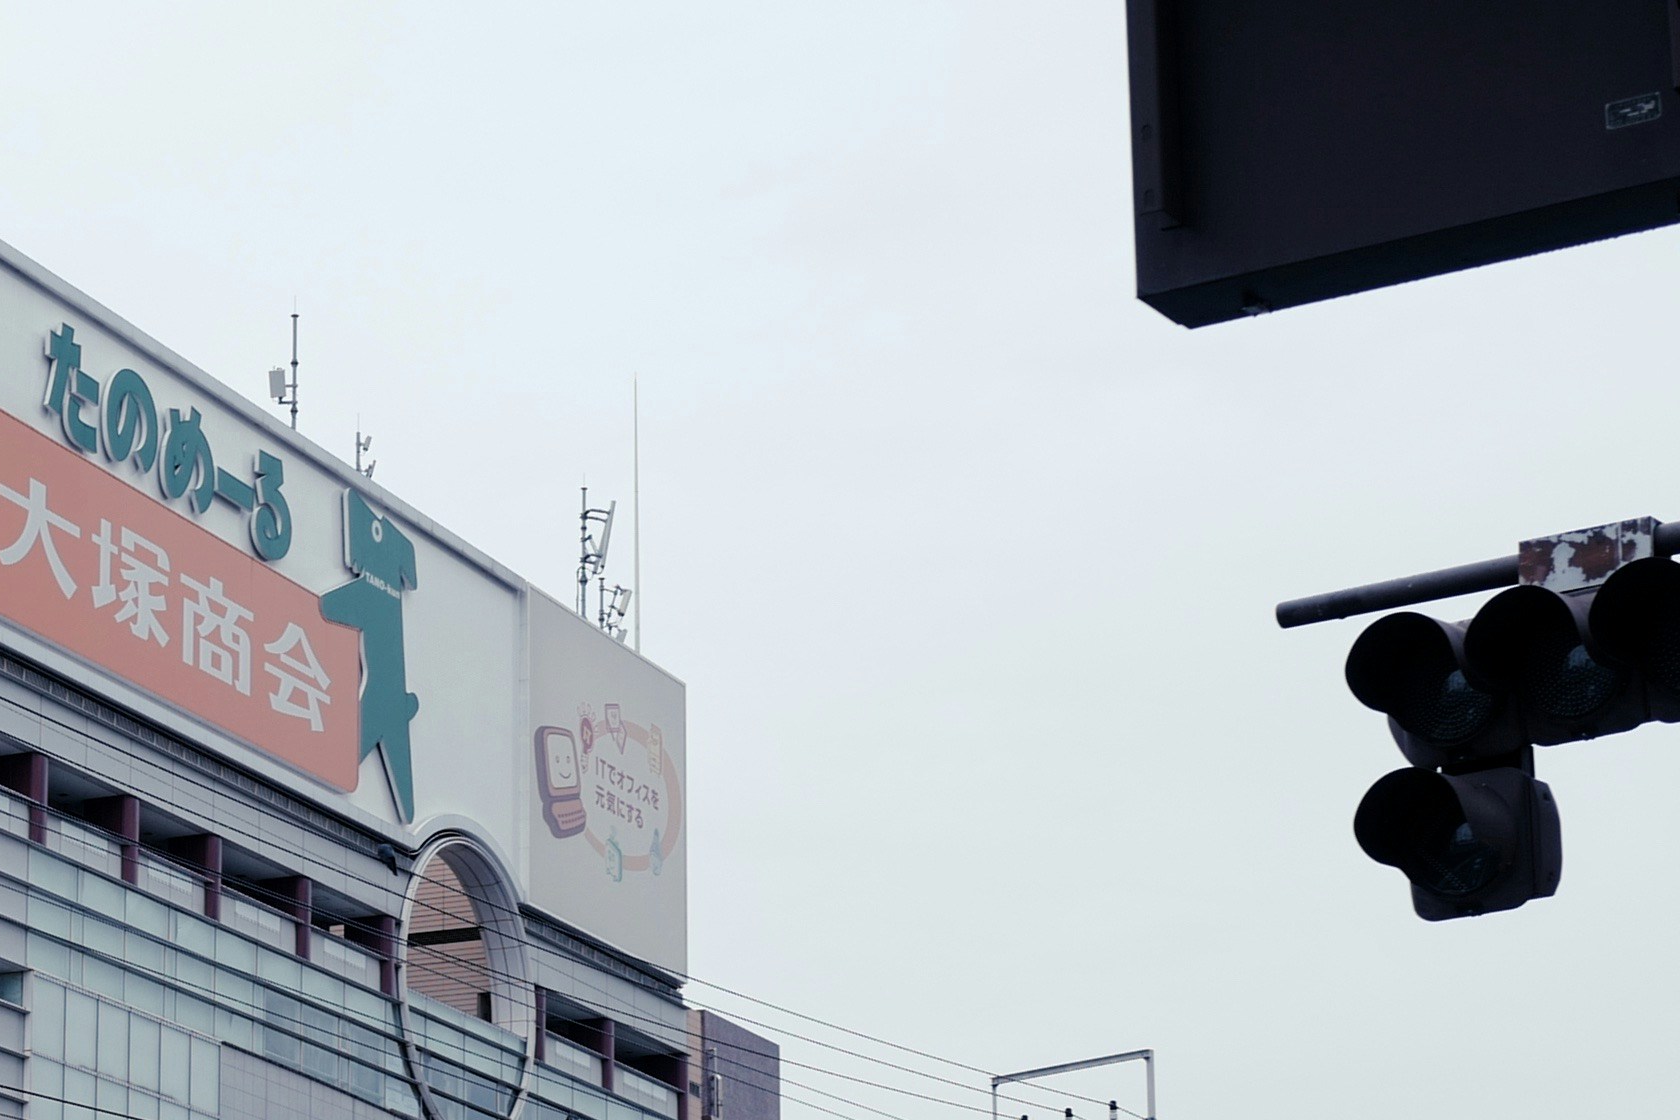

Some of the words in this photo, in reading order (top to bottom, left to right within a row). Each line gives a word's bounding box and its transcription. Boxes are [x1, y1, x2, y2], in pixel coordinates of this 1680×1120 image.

[43, 322, 294, 560] たのめーる
[594, 784, 644, 829] 元気にする
